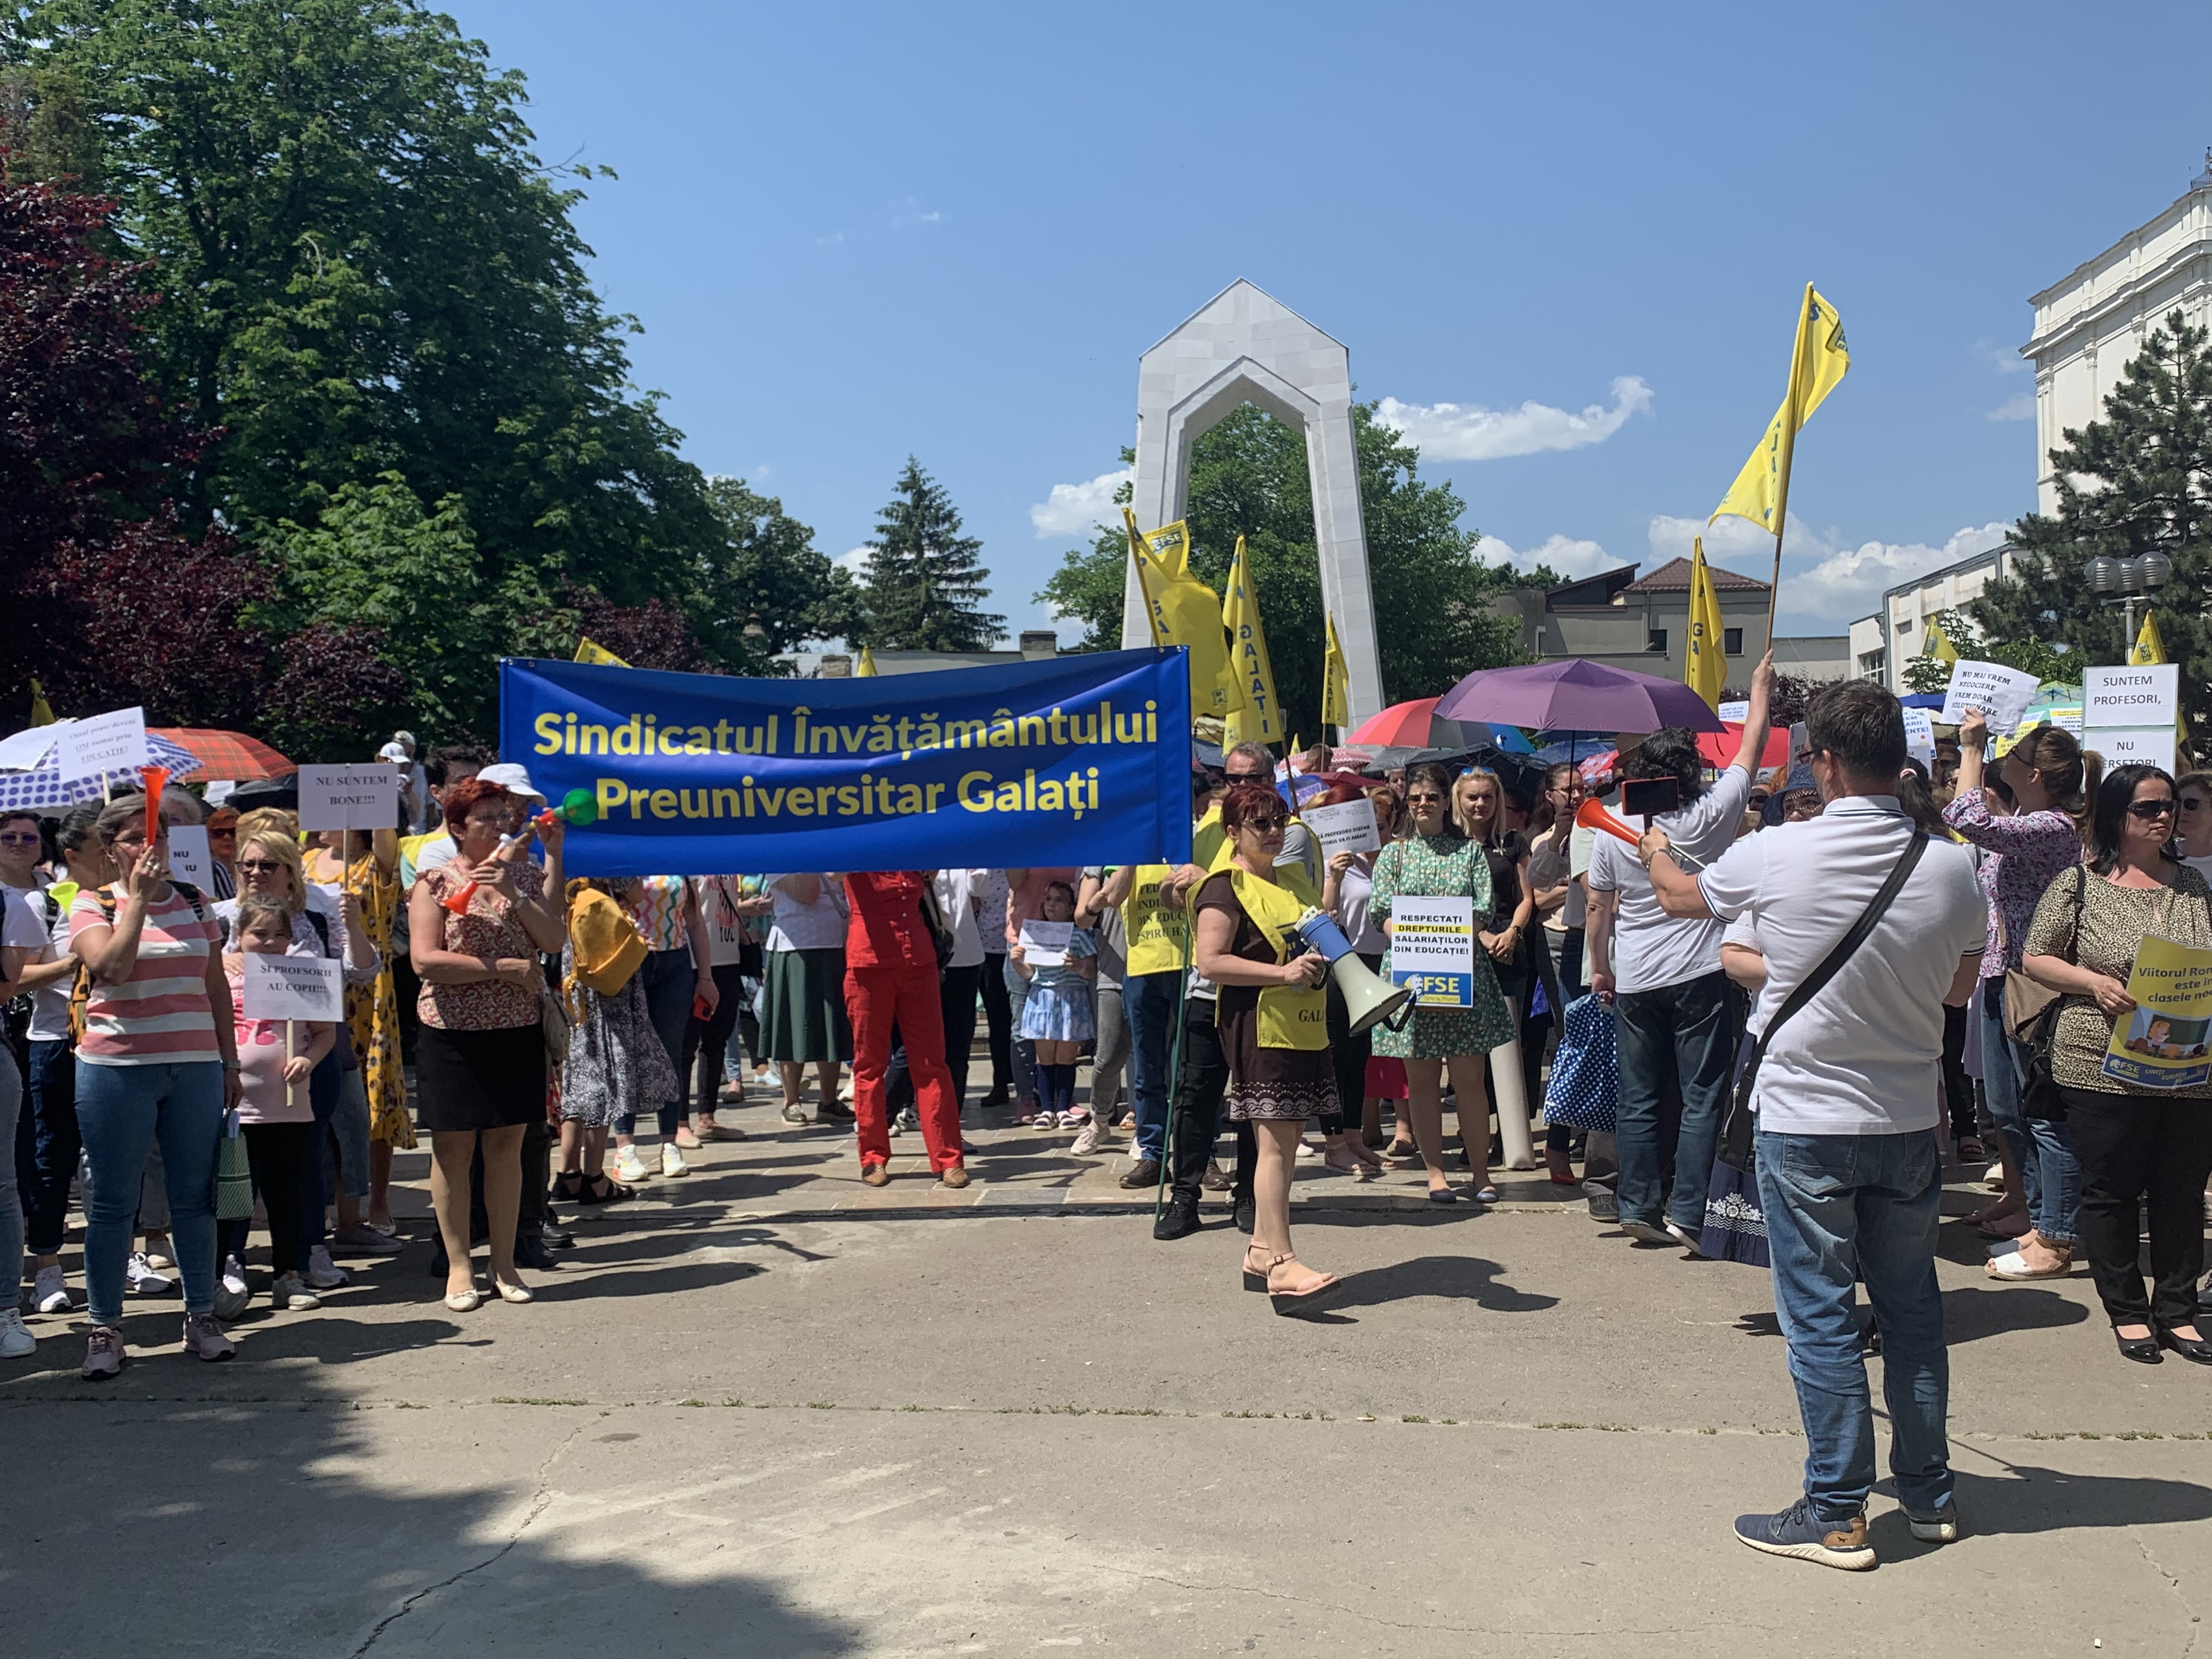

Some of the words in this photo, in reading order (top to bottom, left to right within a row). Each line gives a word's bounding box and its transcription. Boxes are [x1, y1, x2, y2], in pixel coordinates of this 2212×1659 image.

[1988, 674, 2011, 685] VREM
[2103, 676, 2152, 686] SUNTEM
[1958, 681, 1996, 691] NEGOCIERE
[1972, 693, 1993, 703] DOAR
[2094, 695, 2161, 705] PROFESORI,
[91, 725, 109, 735] poate
[111, 718, 136, 728] deveni
[533, 712, 778, 755] Sindicatul
[791, 700, 1157, 760] Învățământului
[76, 743, 89, 752] OM
[116, 733, 132, 742] prin
[2117, 742, 2134, 751] NU
[316, 777, 334, 786] NU
[336, 776, 387, 786] SUNTEM
[596, 774, 945, 820] Preuniversitar
[957, 767, 1099, 820] Galați
[330, 795, 375, 805] BONE!!!
[1324, 828, 1352, 838] PROFESORII
[1157, 911, 1184, 922] EDUC
[1401, 915, 1462, 924] RESPECTAȚI
[1399, 925, 1461, 933] DREPTURILE
[1395, 936, 1468, 945] SALARIAȚILOR
[1415, 946, 1469, 956] EDUCAȚIE!
[274, 966, 331, 977] PROFSORII
[2139, 967, 2186, 977] Viitorul
[286, 983, 326, 993] COPII!!!
[1424, 977, 1460, 992] FSE
[2175, 980, 2200, 990] este
[2148, 992, 2191, 1002] clasele
[2120, 1062, 2140, 1074] FSE
